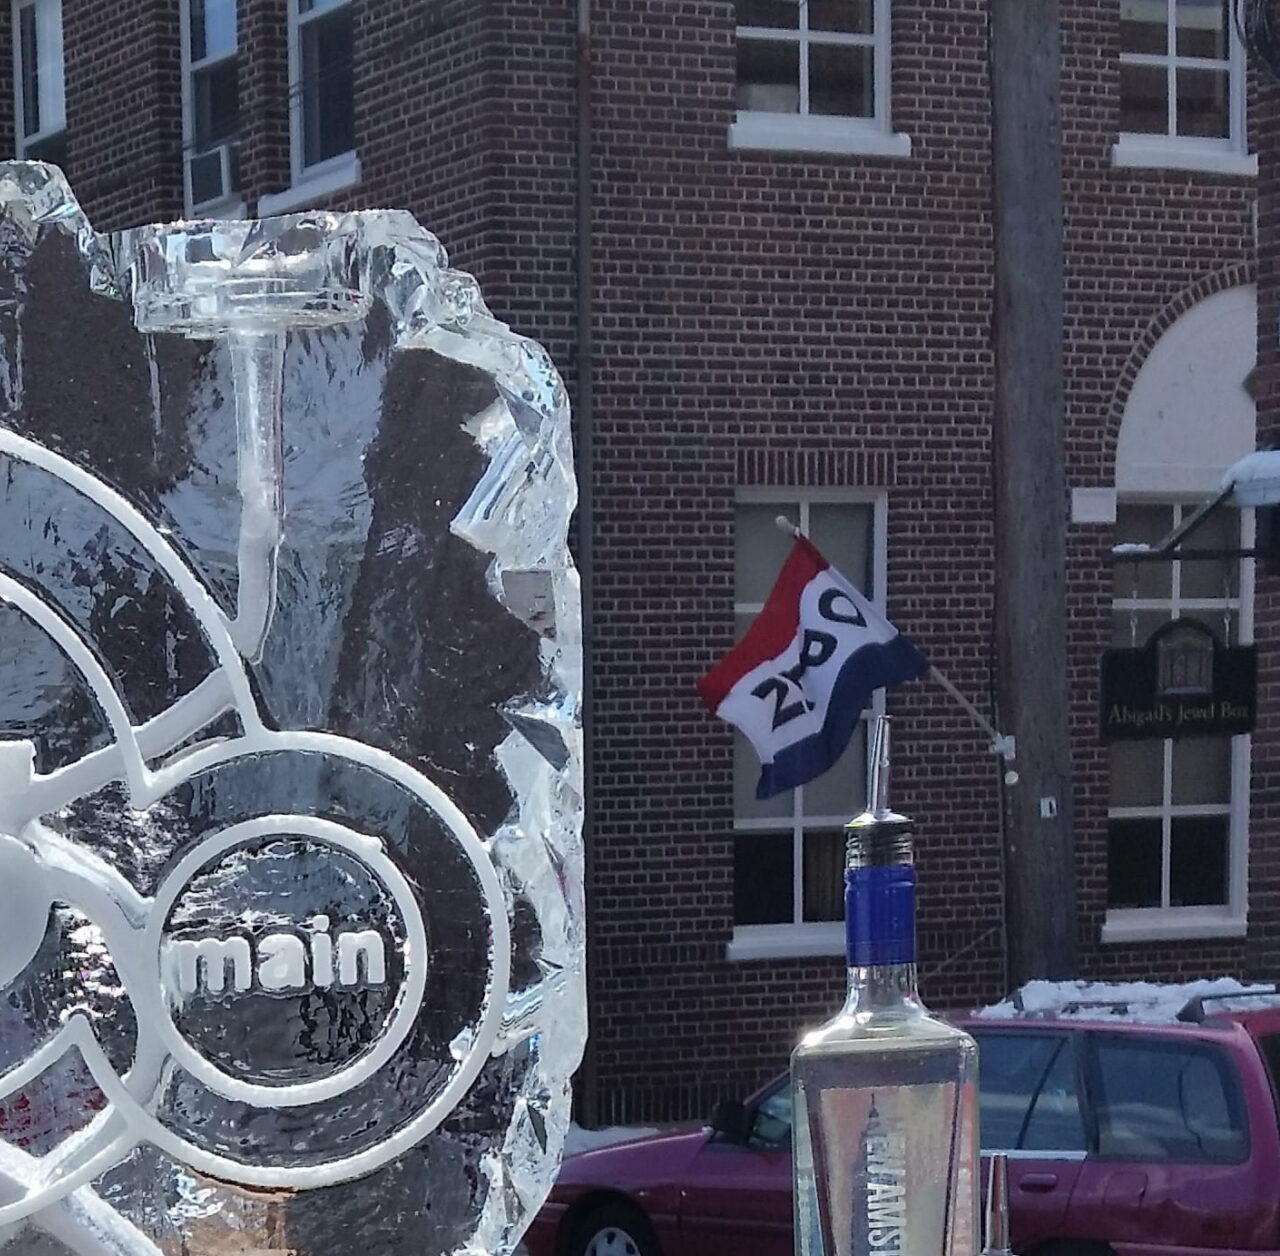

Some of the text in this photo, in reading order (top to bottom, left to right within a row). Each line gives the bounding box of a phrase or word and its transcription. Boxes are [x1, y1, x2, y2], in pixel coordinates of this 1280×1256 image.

[1175, 703, 1214, 725] Jewel
[1221, 700, 1248, 719] Box
[169, 916, 386, 994] main
